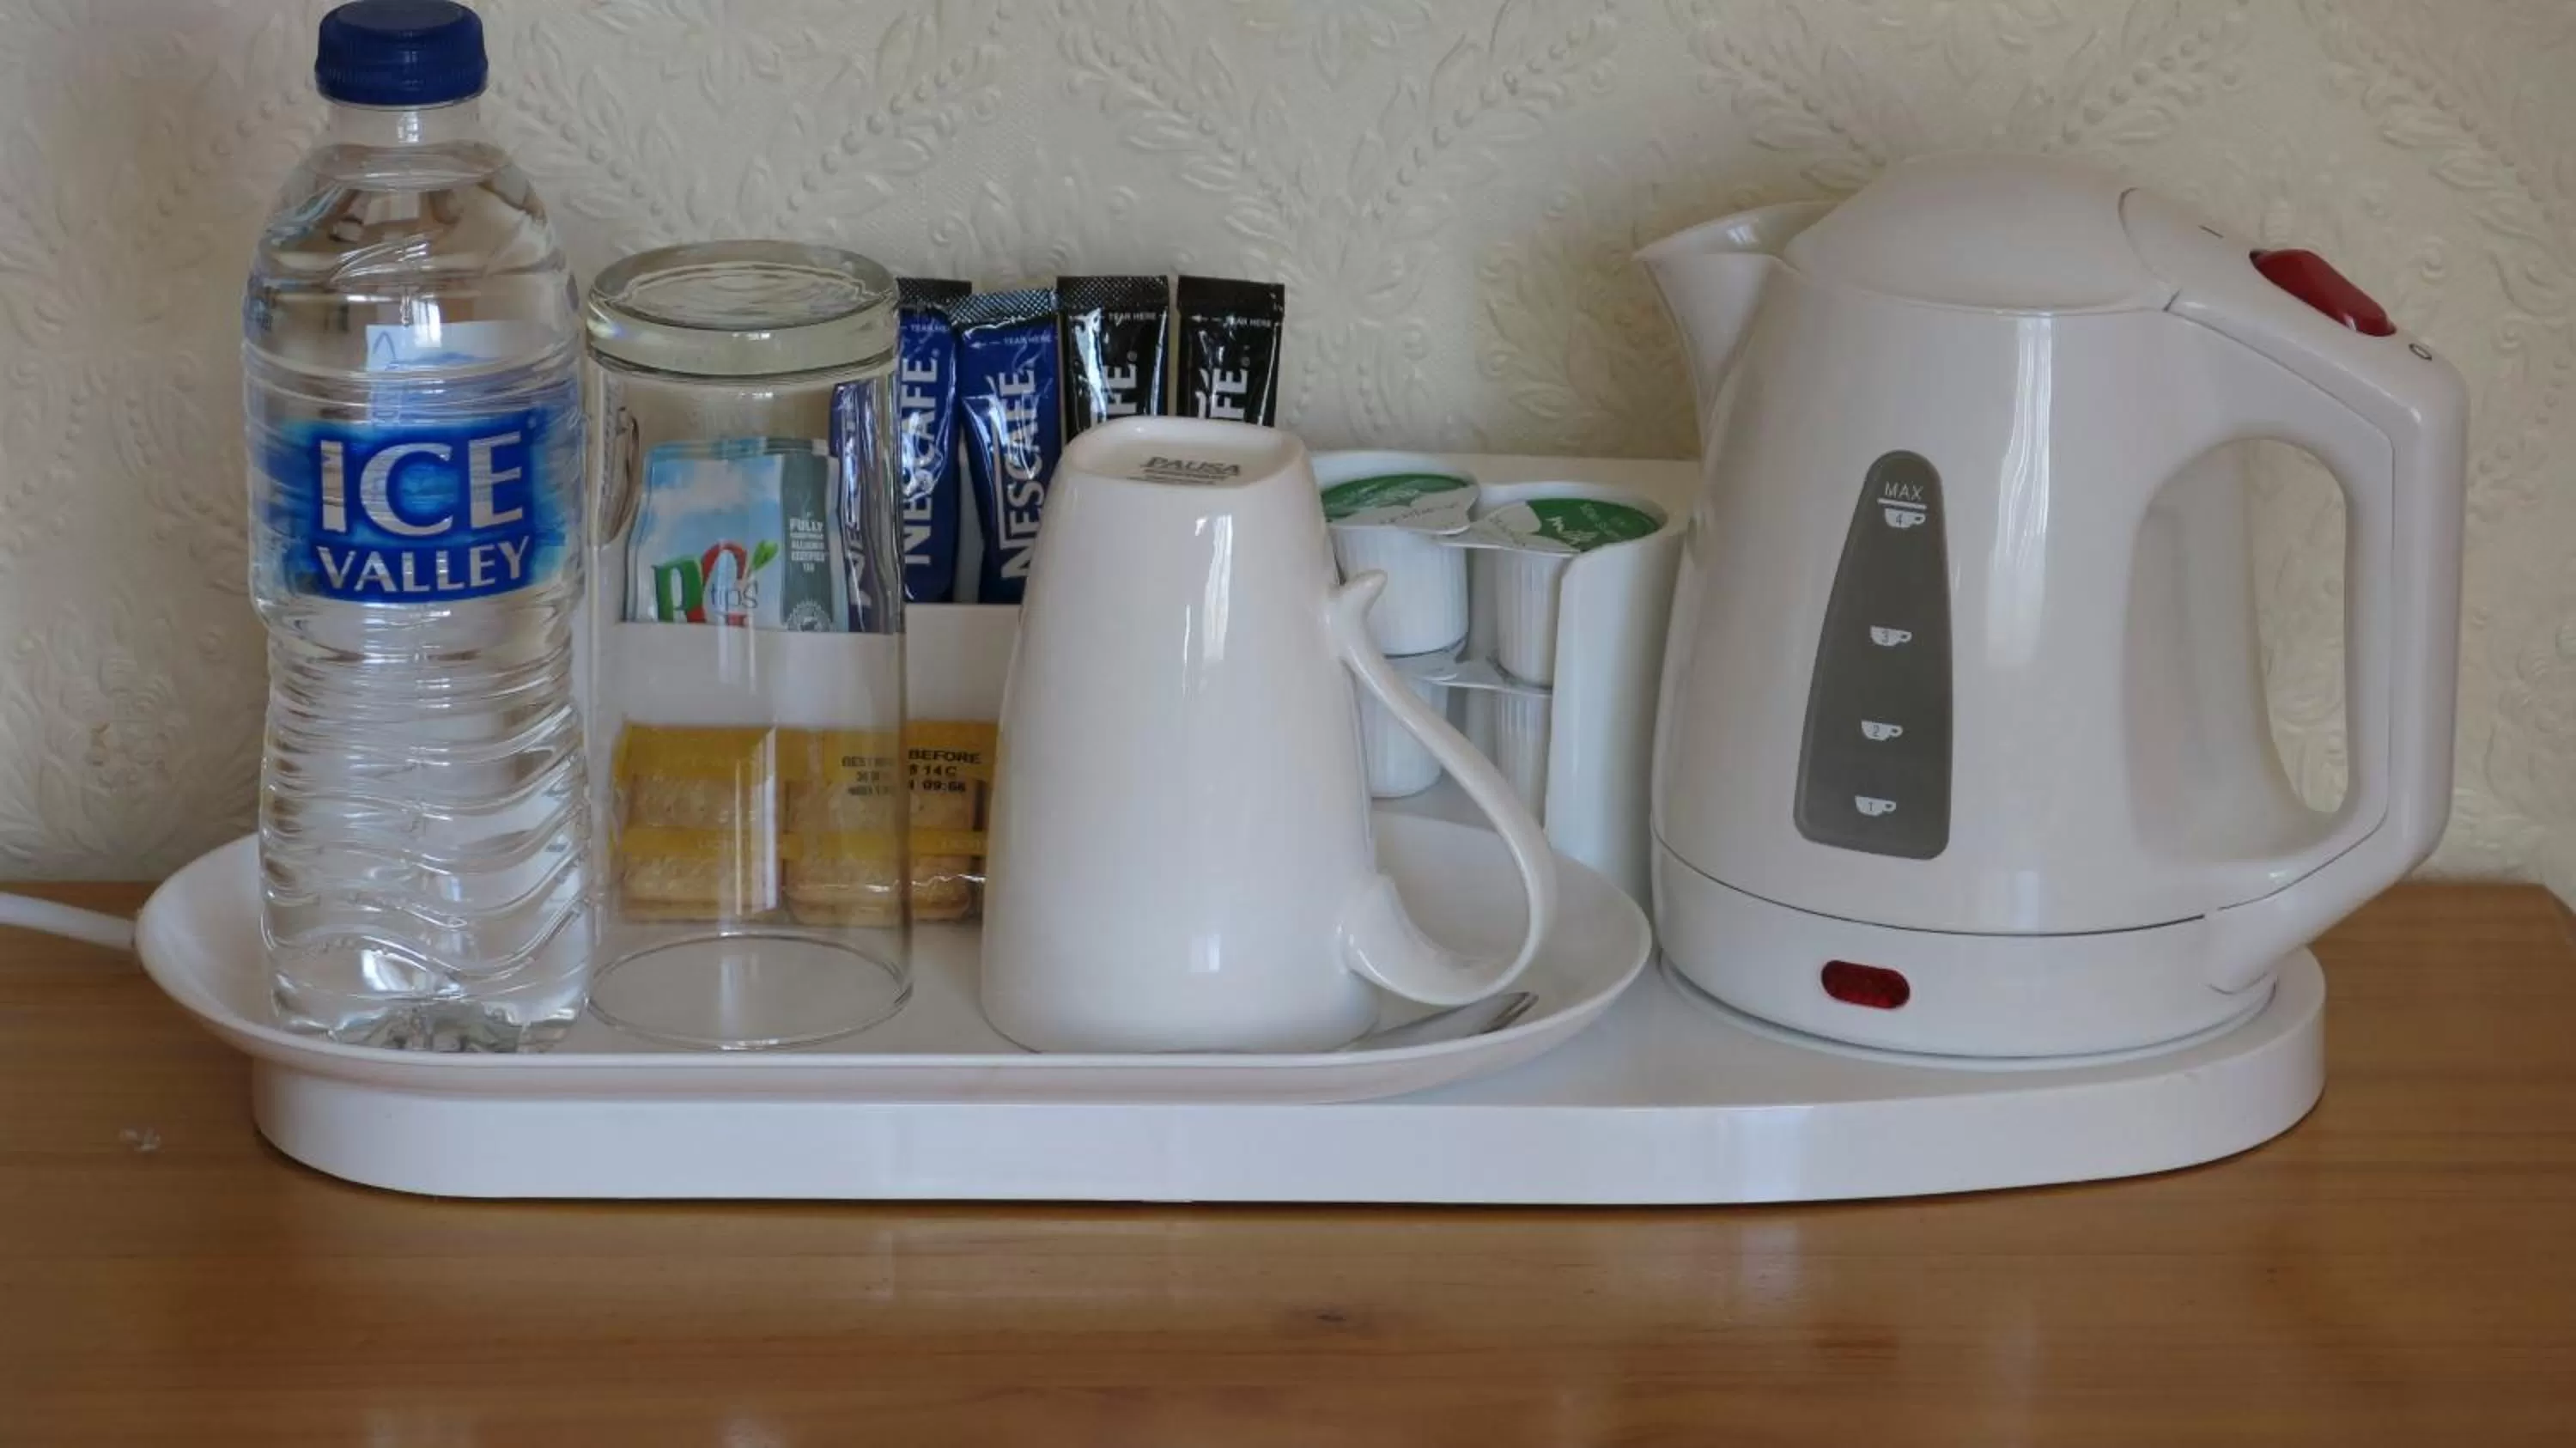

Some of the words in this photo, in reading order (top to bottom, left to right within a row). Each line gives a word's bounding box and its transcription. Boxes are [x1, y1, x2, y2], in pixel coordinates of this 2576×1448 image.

[1108, 311, 1131, 321] TEAR
[1133, 311, 1157, 321] HERE
[1249, 317, 1272, 328] HERE
[1003, 335, 1028, 345] TEAR
[1139, 455, 1241, 478] PAUSA
[319, 430, 524, 537] ICE
[1884, 481, 1924, 501] MAX
[789, 518, 824, 532] FULLY
[315, 534, 531, 593] VALLEY
[710, 579, 759, 611] tips
[908, 749, 982, 764] BEFORE
